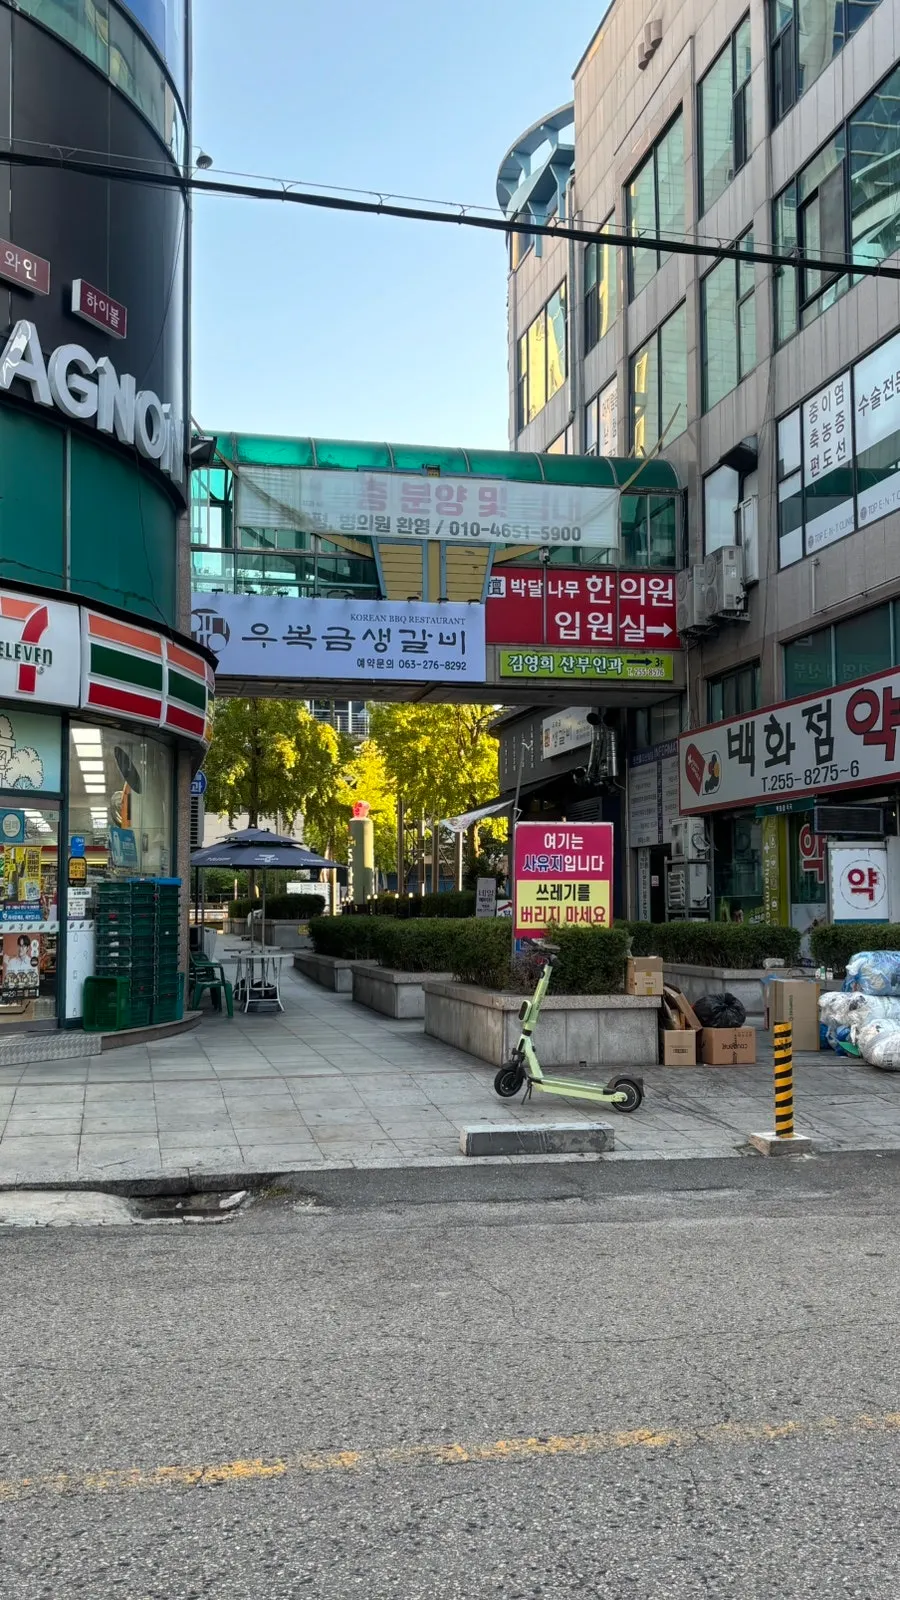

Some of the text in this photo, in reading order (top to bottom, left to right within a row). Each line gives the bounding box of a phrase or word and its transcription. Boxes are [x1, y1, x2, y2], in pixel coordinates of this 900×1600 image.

[4, 251, 37, 282] 와인
[86, 291, 120, 328] 하이볼
[808, 381, 845, 426] 중이염
[808, 410, 846, 449] 축농증
[809, 437, 847, 479] 편도선
[401, 481, 468, 517] 분양
[396, 516, 430, 536] 환영
[449, 520, 583, 542] 010-4651-5900
[510, 578, 580, 599] 박달나무
[585, 574, 674, 607] 한의원
[350, 613, 466, 626] KOREAN BBQ RESTAURANT
[554, 610, 645, 643] 입원실
[356, 657, 467, 672] 예약문의 063-276-8292
[508, 653, 555, 673] 김영희
[559, 655, 624, 675] 산부인과
[726, 686, 900, 778] 백화점 약
[761, 759, 860, 793] T.255-8275~6
[543, 832, 584, 850] 여기는
[523, 854, 605, 873] 사유지입니다
[535, 883, 591, 902] 쓰레기를
[847, 867, 881, 902] 약
[520, 905, 607, 924] 버리지 마세요
